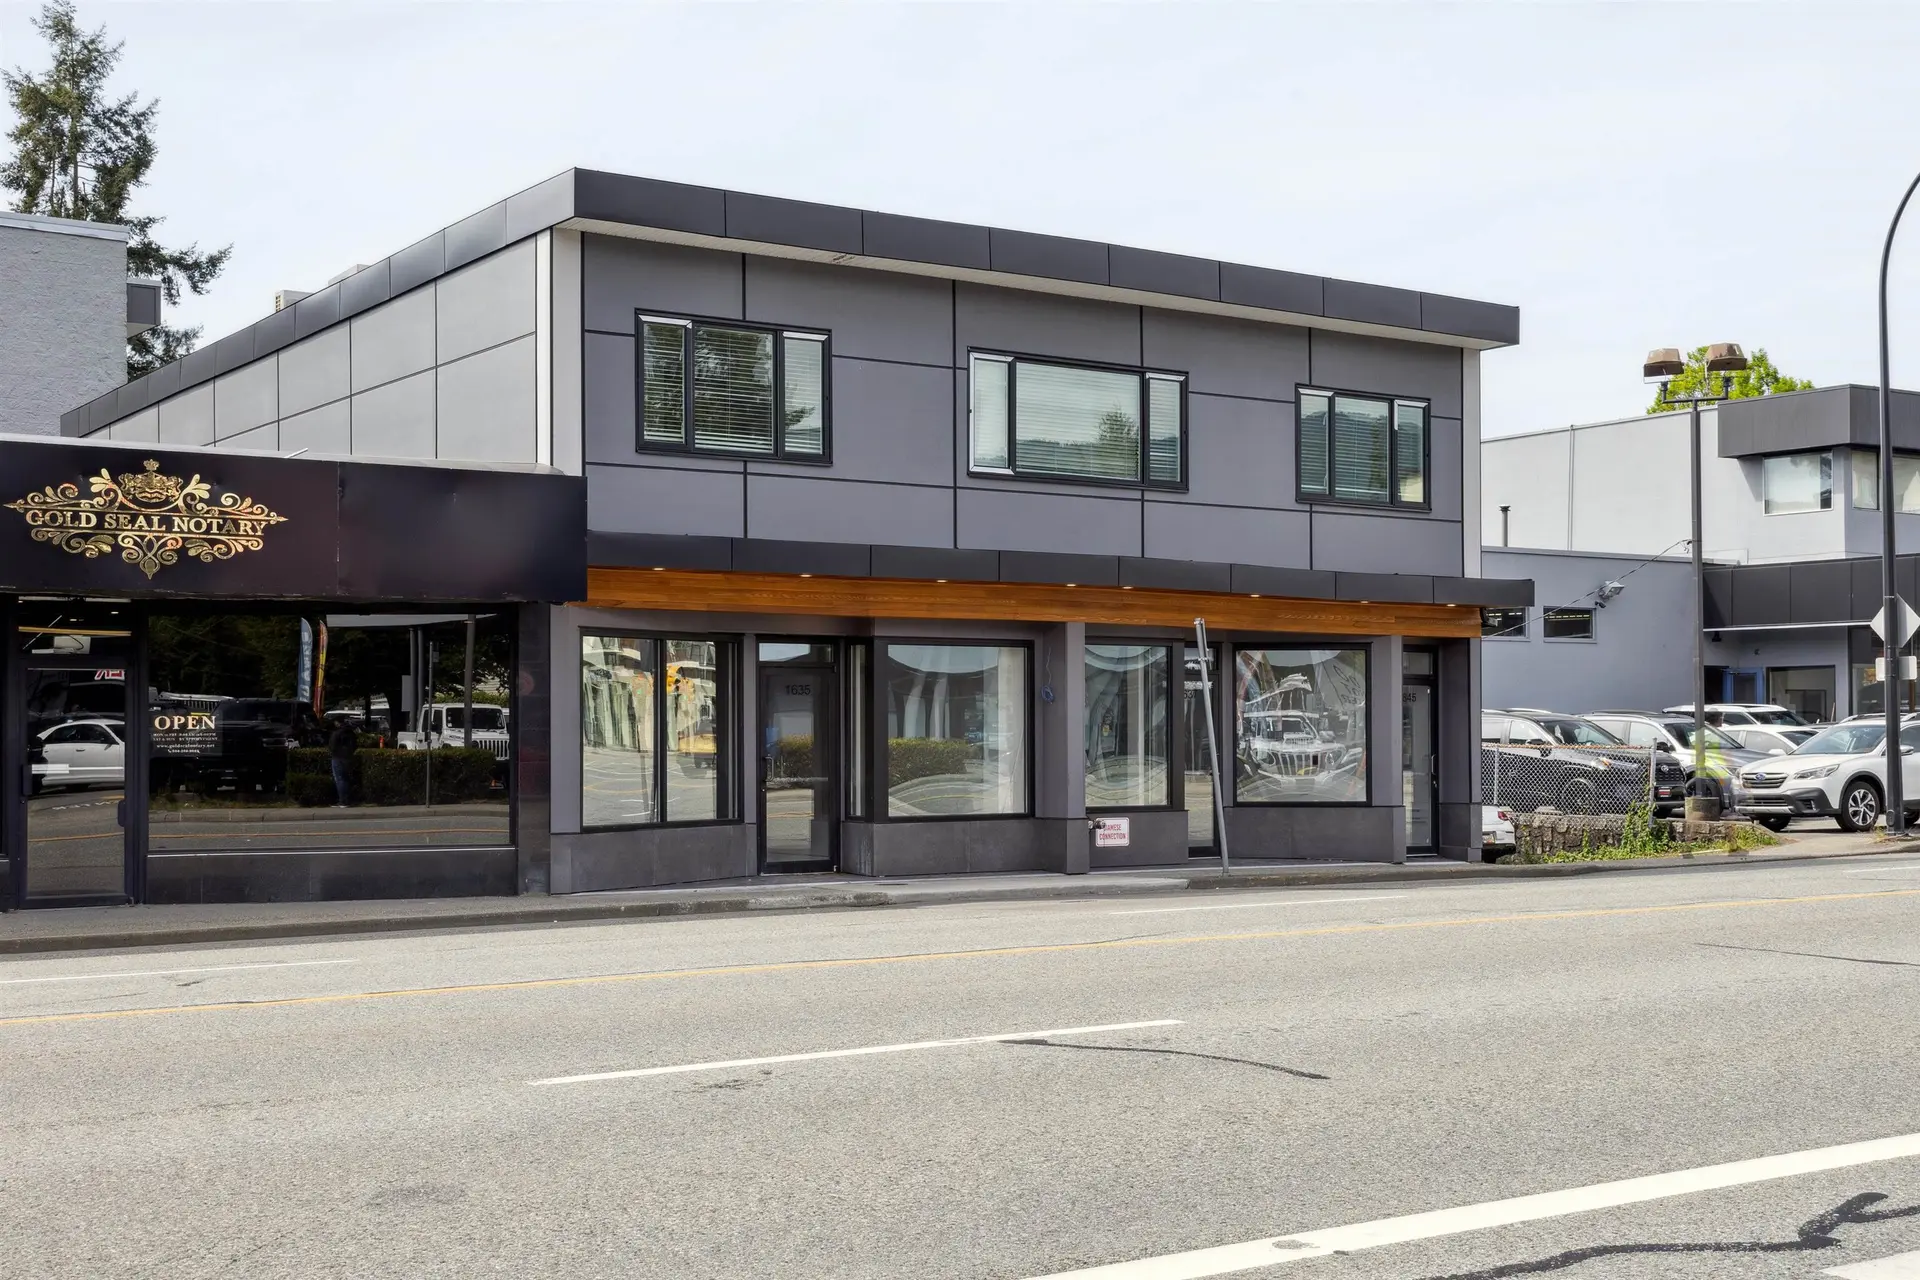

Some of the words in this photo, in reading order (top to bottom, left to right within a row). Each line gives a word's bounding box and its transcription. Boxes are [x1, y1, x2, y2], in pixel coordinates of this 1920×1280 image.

[26, 510, 97, 528] GOLD
[104, 513, 166, 531] SEAL
[172, 516, 268, 536] NOTARY
[785, 684, 811, 696] 1635
[154, 715, 217, 730] OPEN
[1099, 832, 1128, 840] CONNECTION
